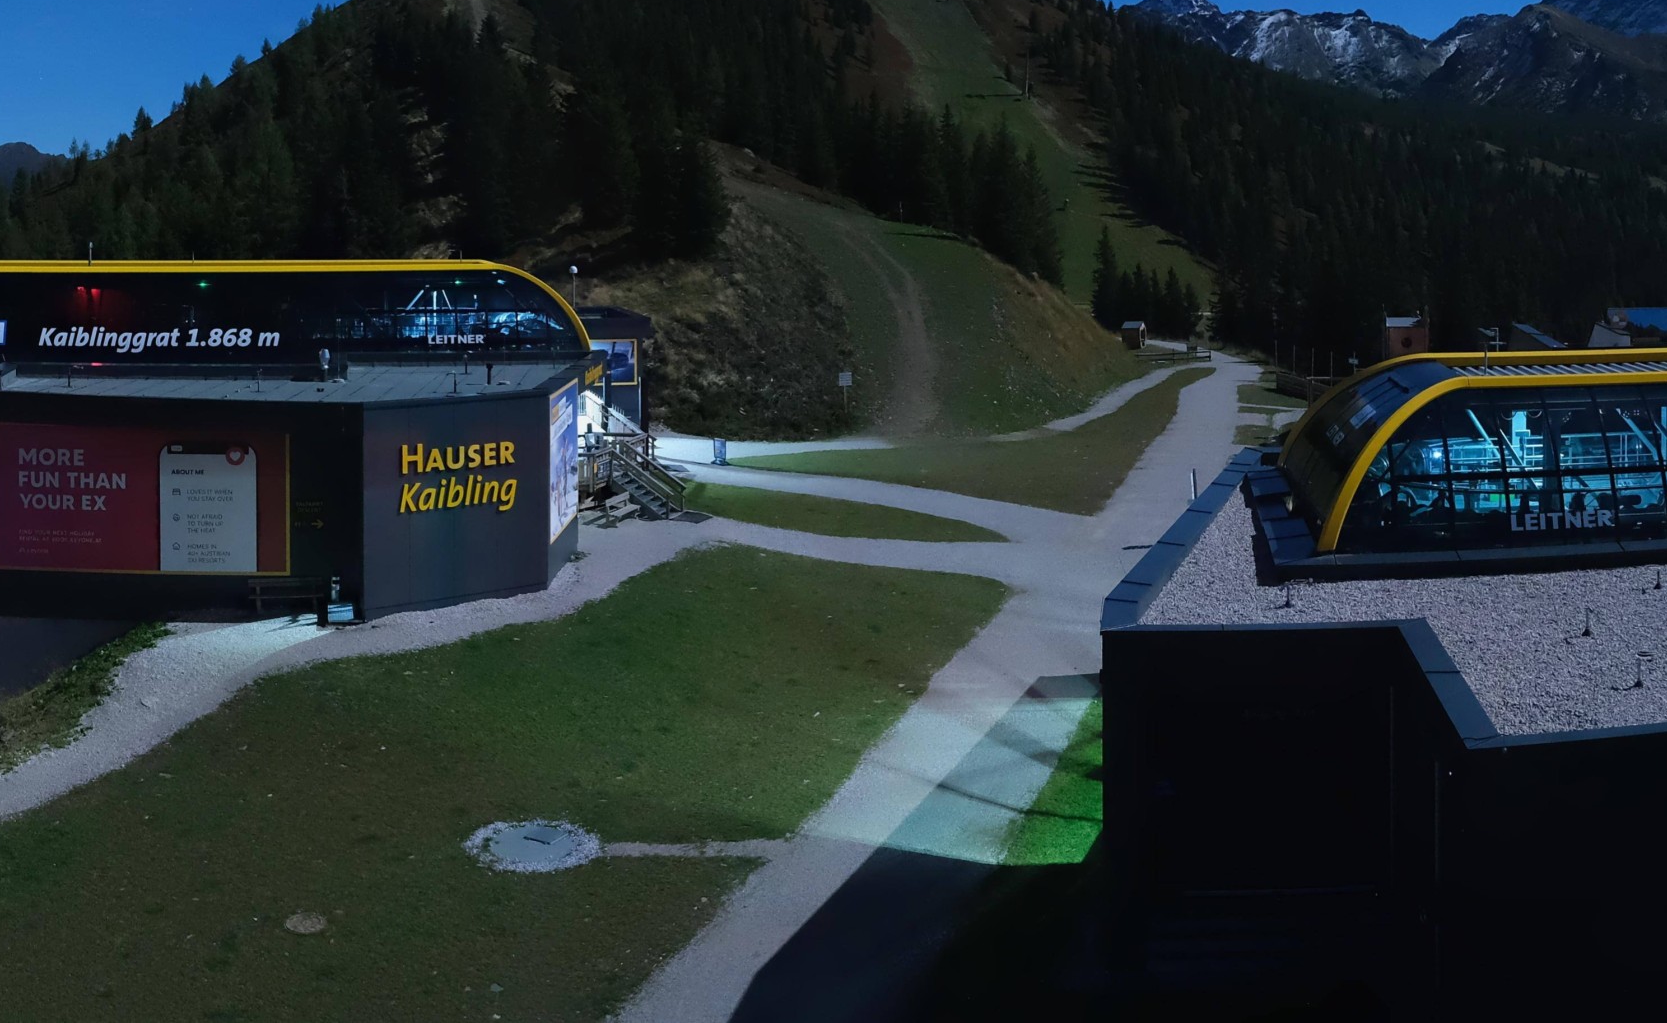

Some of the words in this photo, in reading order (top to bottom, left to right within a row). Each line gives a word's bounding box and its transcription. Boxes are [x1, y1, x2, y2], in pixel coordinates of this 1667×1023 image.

[38, 326, 180, 353] Kaiblinggrat
[185, 327, 252, 347] 1.868
[256, 331, 281, 347] m
[428, 334, 485, 345] LEITNER
[18, 447, 85, 466] MORE
[400, 441, 516, 475] HAUSER
[18, 470, 60, 488] FUN
[66, 472, 127, 490] THAN
[19, 493, 76, 511] YOUR
[81, 494, 107, 511] EX
[399, 475, 518, 514] Kaibling
[1510, 509, 1614, 532] LEITNER
